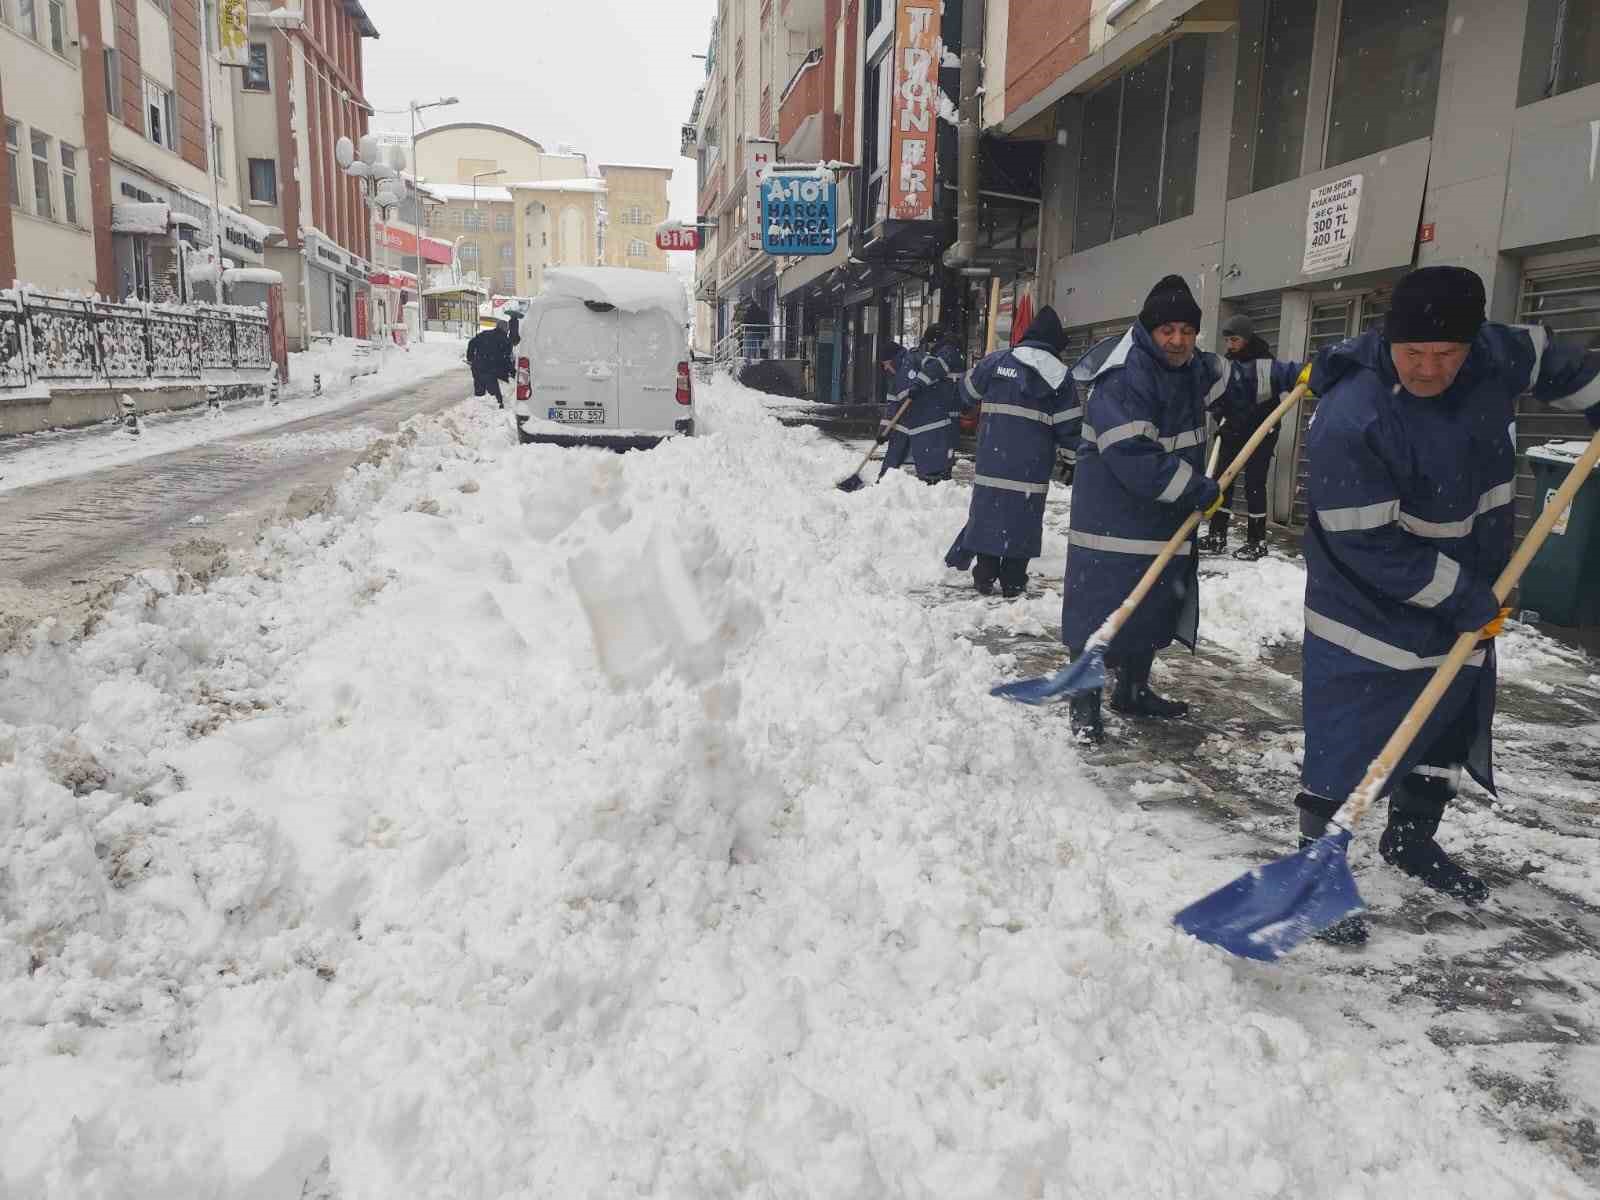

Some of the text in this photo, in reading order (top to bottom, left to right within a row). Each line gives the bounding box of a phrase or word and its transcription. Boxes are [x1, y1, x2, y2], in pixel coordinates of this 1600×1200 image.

[768, 203, 829, 218] HARCA
[1313, 213, 1348, 234] 300 TL
[1311, 228, 1346, 248] 400 TL
[588, 410, 602, 420] 557
